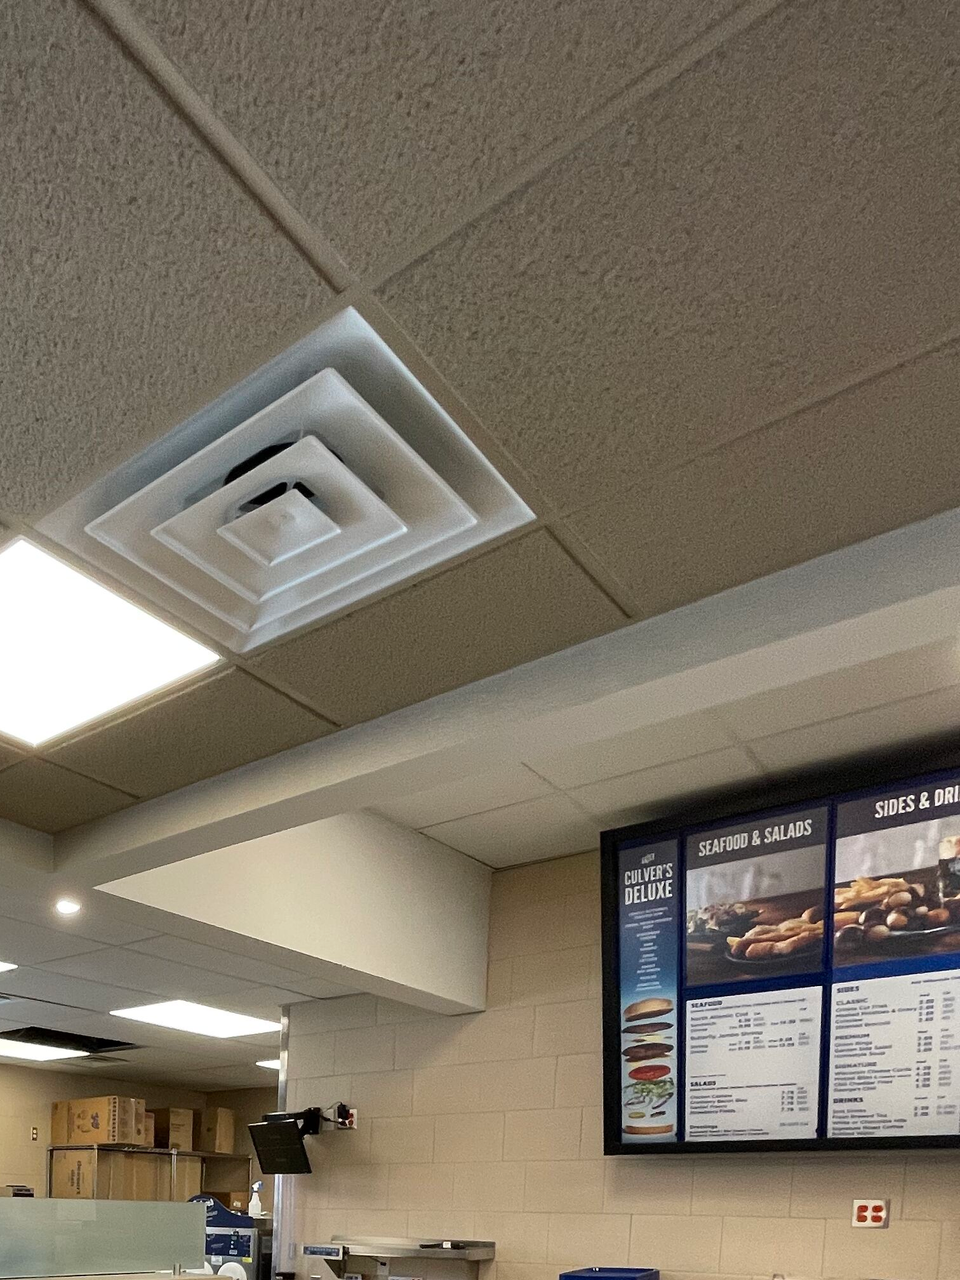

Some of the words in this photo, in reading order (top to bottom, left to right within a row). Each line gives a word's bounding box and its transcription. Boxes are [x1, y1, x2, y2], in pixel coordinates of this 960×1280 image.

[874, 794, 916, 819] SIDES
[918, 790, 931, 810] &
[934, 785, 960, 807] DRI
[698, 833, 749, 857] SEAFOOD
[751, 829, 762, 846] &
[764, 818, 813, 844] SALADS
[624, 863, 673, 886] CULVER'S
[624, 880, 673, 905] DELUXE
[691, 1000, 722, 1009] SEAFOOD
